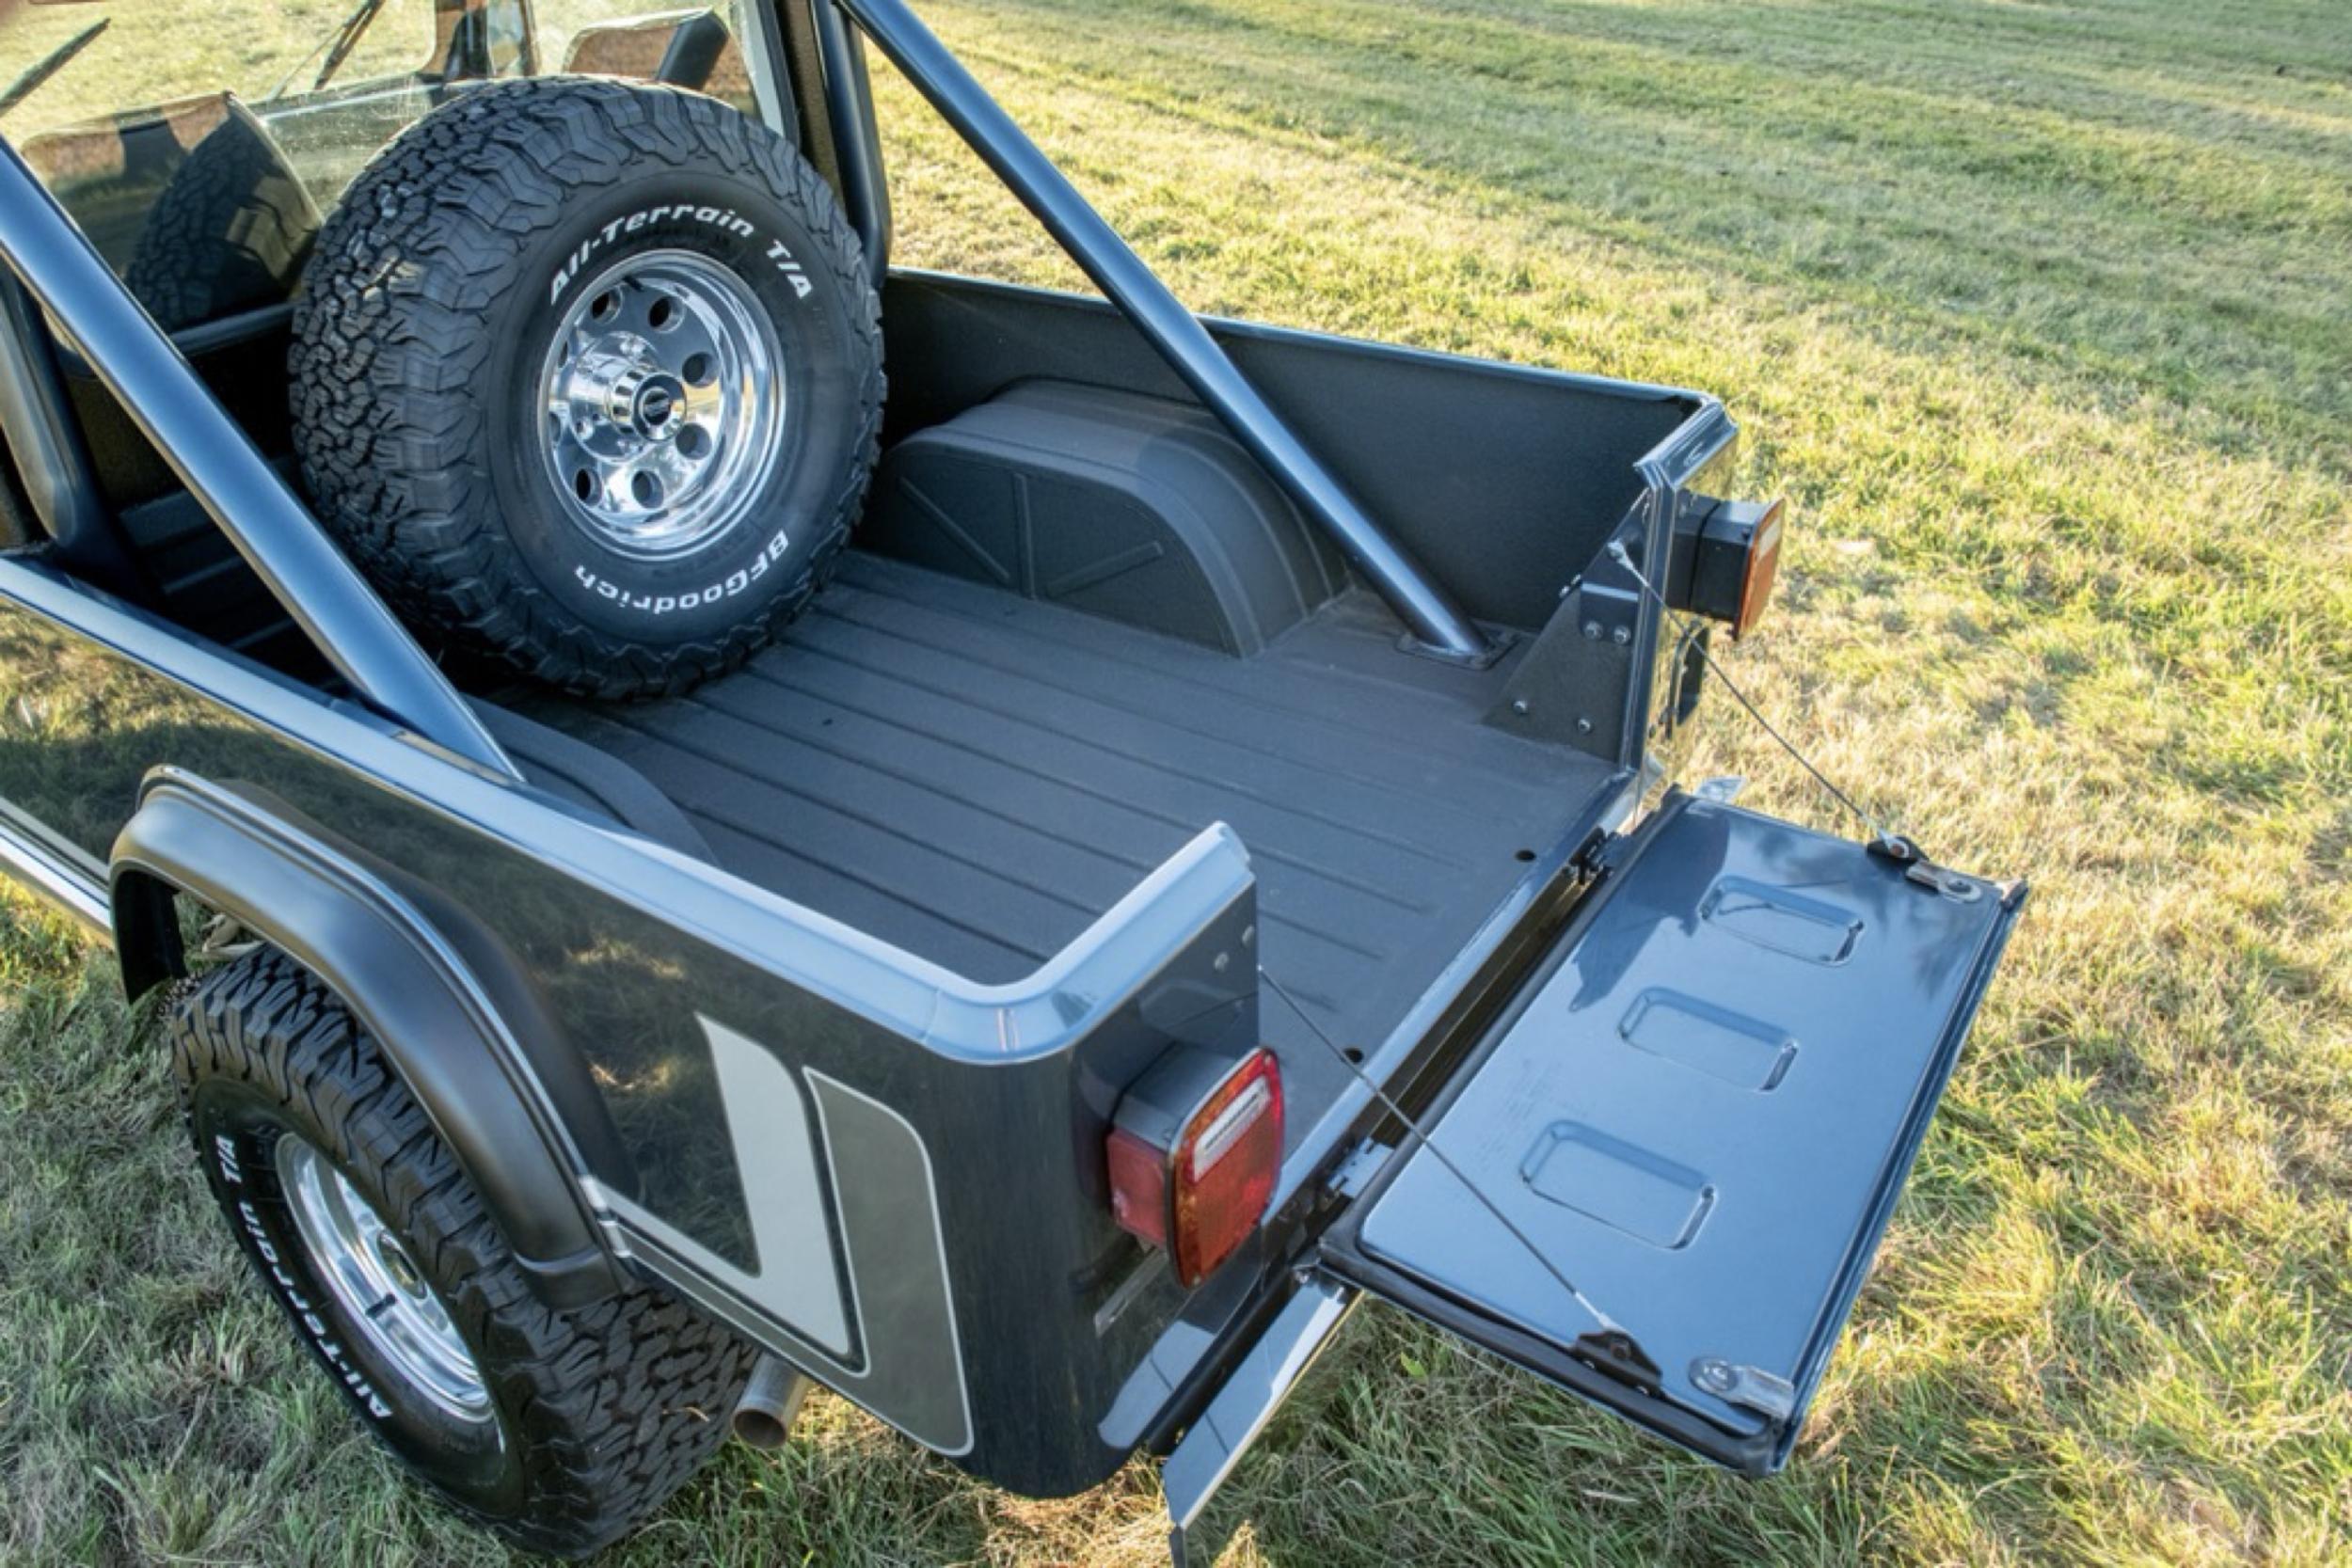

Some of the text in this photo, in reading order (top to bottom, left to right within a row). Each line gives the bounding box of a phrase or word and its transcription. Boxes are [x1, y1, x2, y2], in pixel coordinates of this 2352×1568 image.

[549, 204, 814, 306] All-Terrain T/A
[575, 529, 789, 613] BFGoodrich
[215, 1134, 391, 1418] All-Terrain T/A
